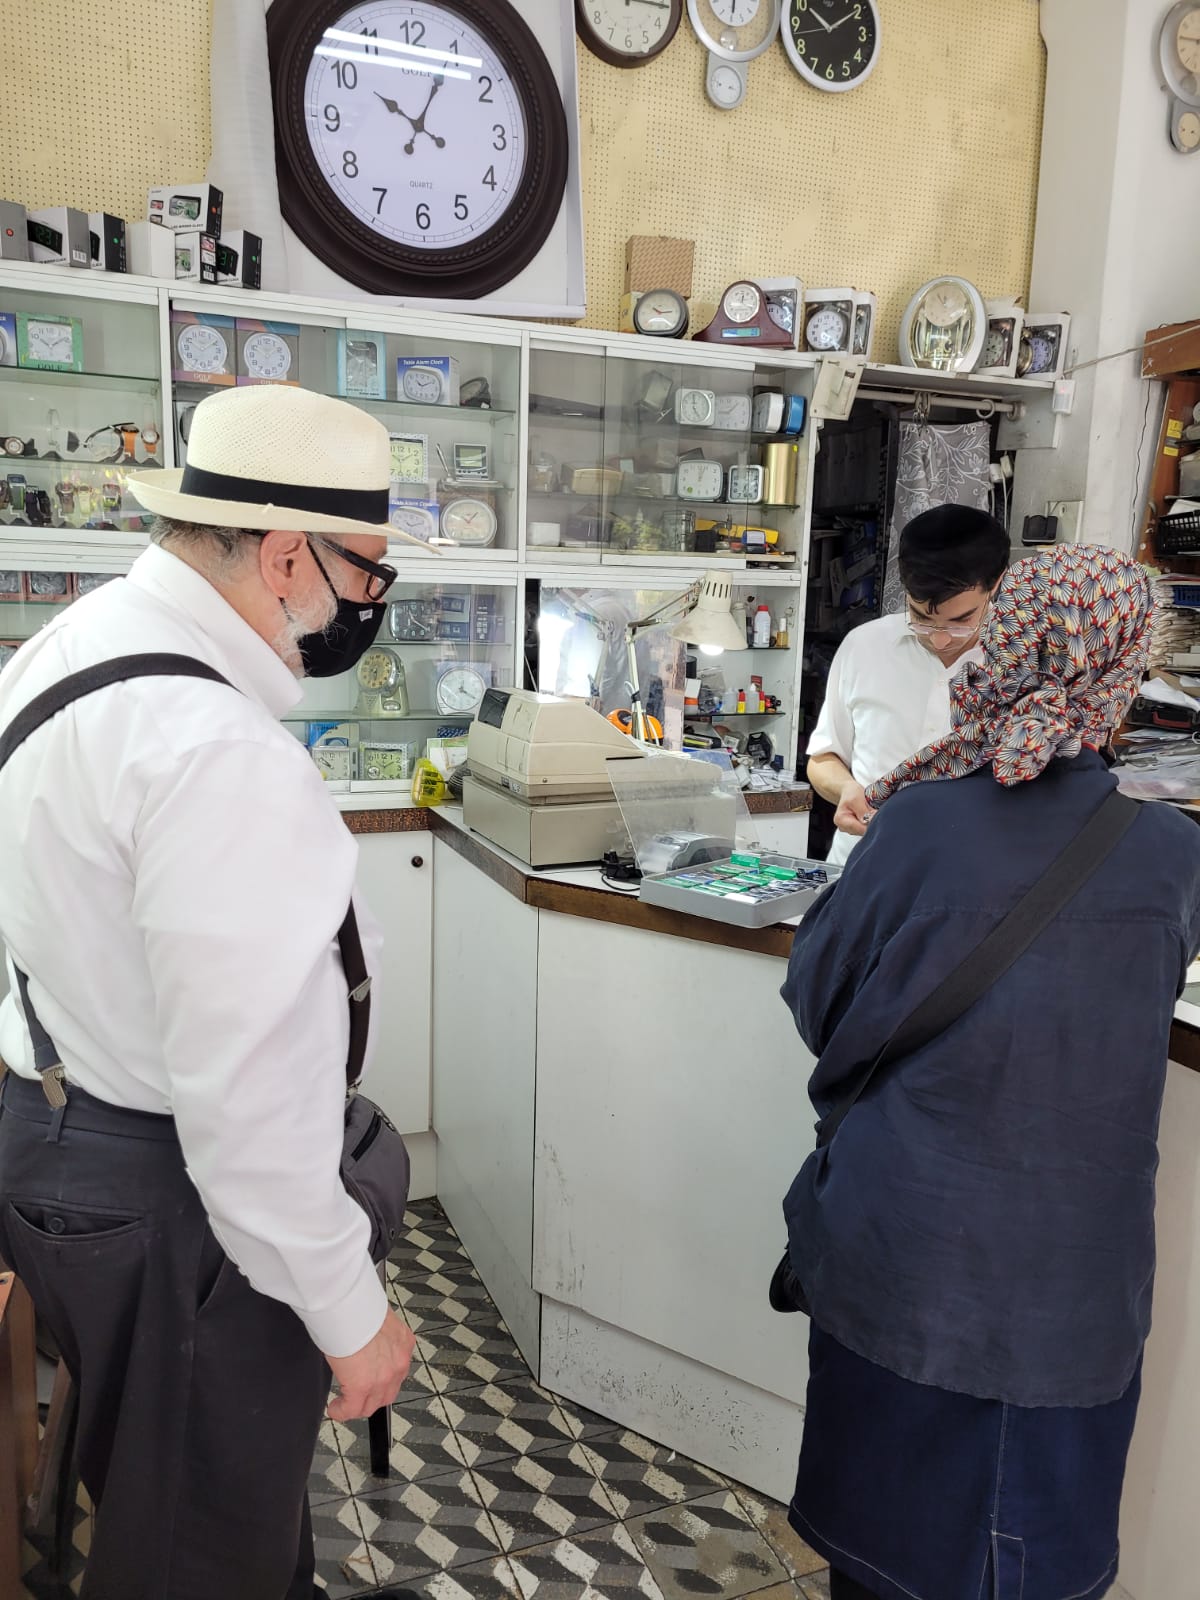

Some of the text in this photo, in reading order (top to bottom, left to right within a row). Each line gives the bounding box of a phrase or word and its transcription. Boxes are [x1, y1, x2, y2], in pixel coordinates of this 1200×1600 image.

[594, 11, 602, 25] 8
[853, 4, 862, 19] 2
[654, 17, 661, 30] 4
[791, 16, 800, 32] 9
[360, 27, 379, 56] 11
[400, 20, 427, 48] 12
[608, 27, 614, 40] 7
[642, 31, 649, 44] 5
[858, 26, 867, 42] 3
[625, 35, 633, 49] 6
[797, 39, 806, 55] 8
[853, 48, 862, 62] 4
[810, 57, 818, 72] 7
[825, 64, 834, 79] 6
[842, 61, 850, 76] 5
[330, 61, 358, 90] 10
[478, 75, 494, 104] 2
[324, 104, 340, 132] 9
[492, 124, 507, 151] 3
[342, 150, 359, 178] 8
[409, 179, 433, 190] QUARTZ
[482, 165, 497, 191] 4
[372, 187, 387, 214] 7
[454, 194, 469, 220] 5
[415, 203, 431, 230] 6
